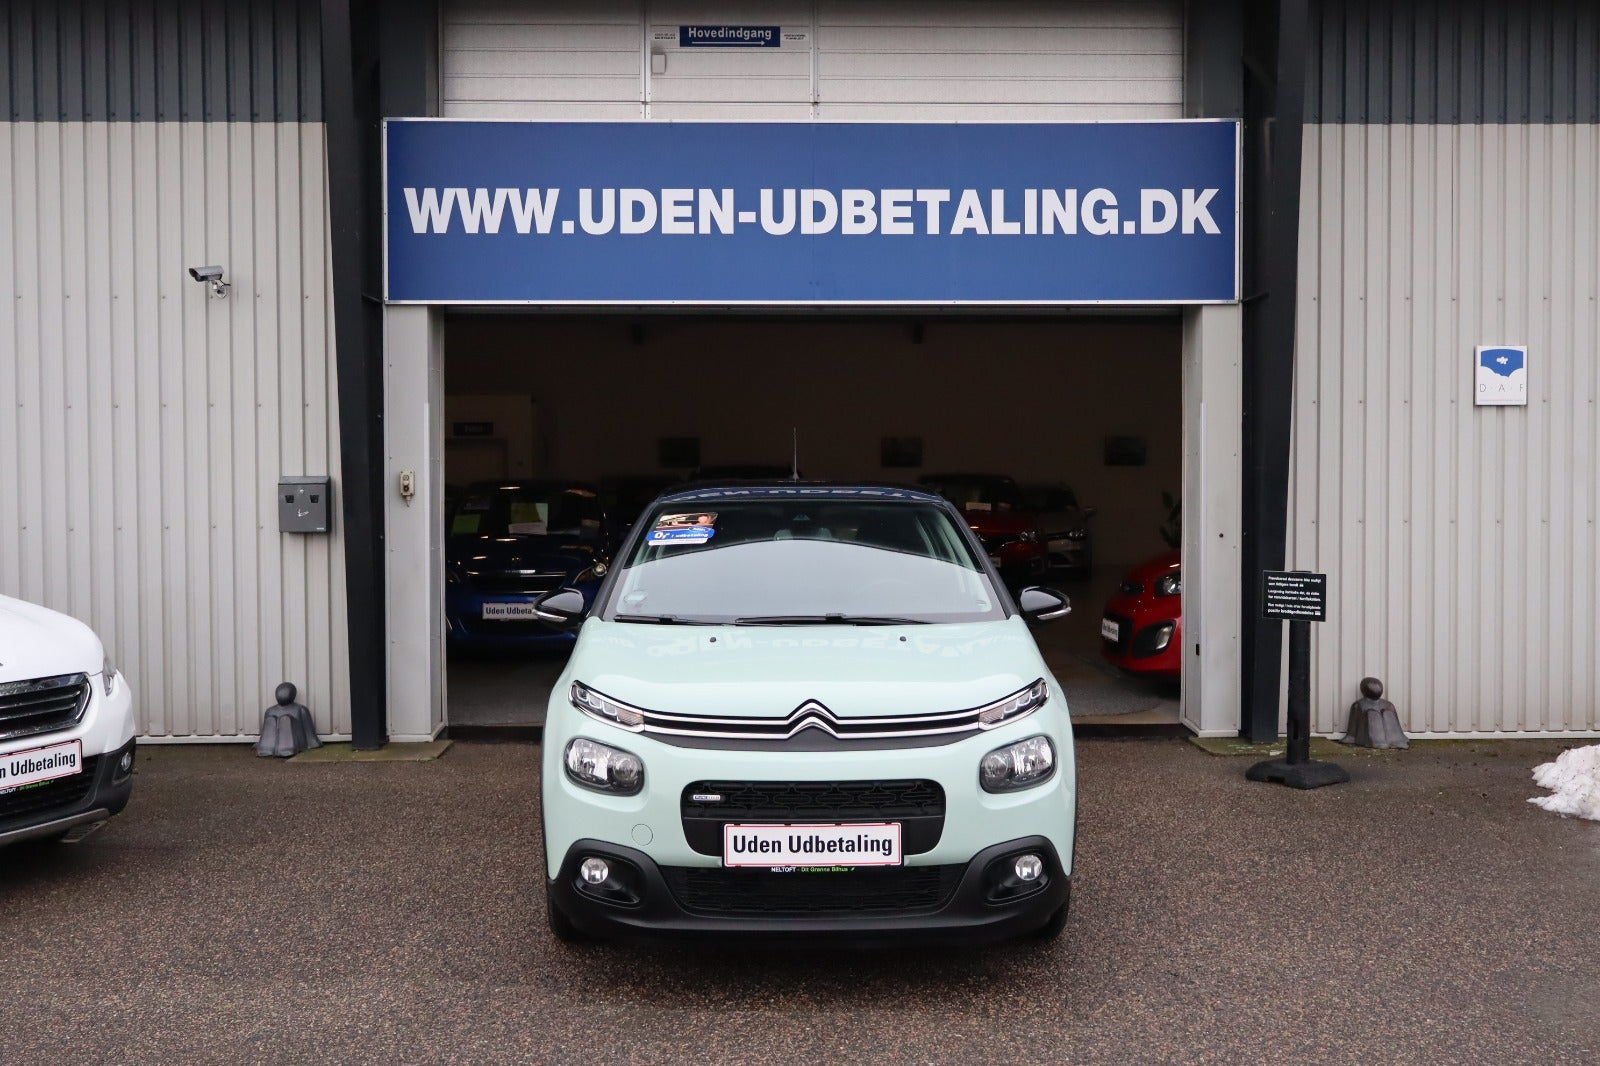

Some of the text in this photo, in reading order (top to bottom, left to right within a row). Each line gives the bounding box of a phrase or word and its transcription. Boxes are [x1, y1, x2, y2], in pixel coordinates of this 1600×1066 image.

[688, 27, 772, 40] Hovedindgang
[403, 187, 1222, 236] WWW.UDEN-UDBETALING.DK
[486, 607, 505, 615] Uden
[10, 752, 76, 777] Udbetaling
[733, 834, 893, 856] Uden Udbetaling
